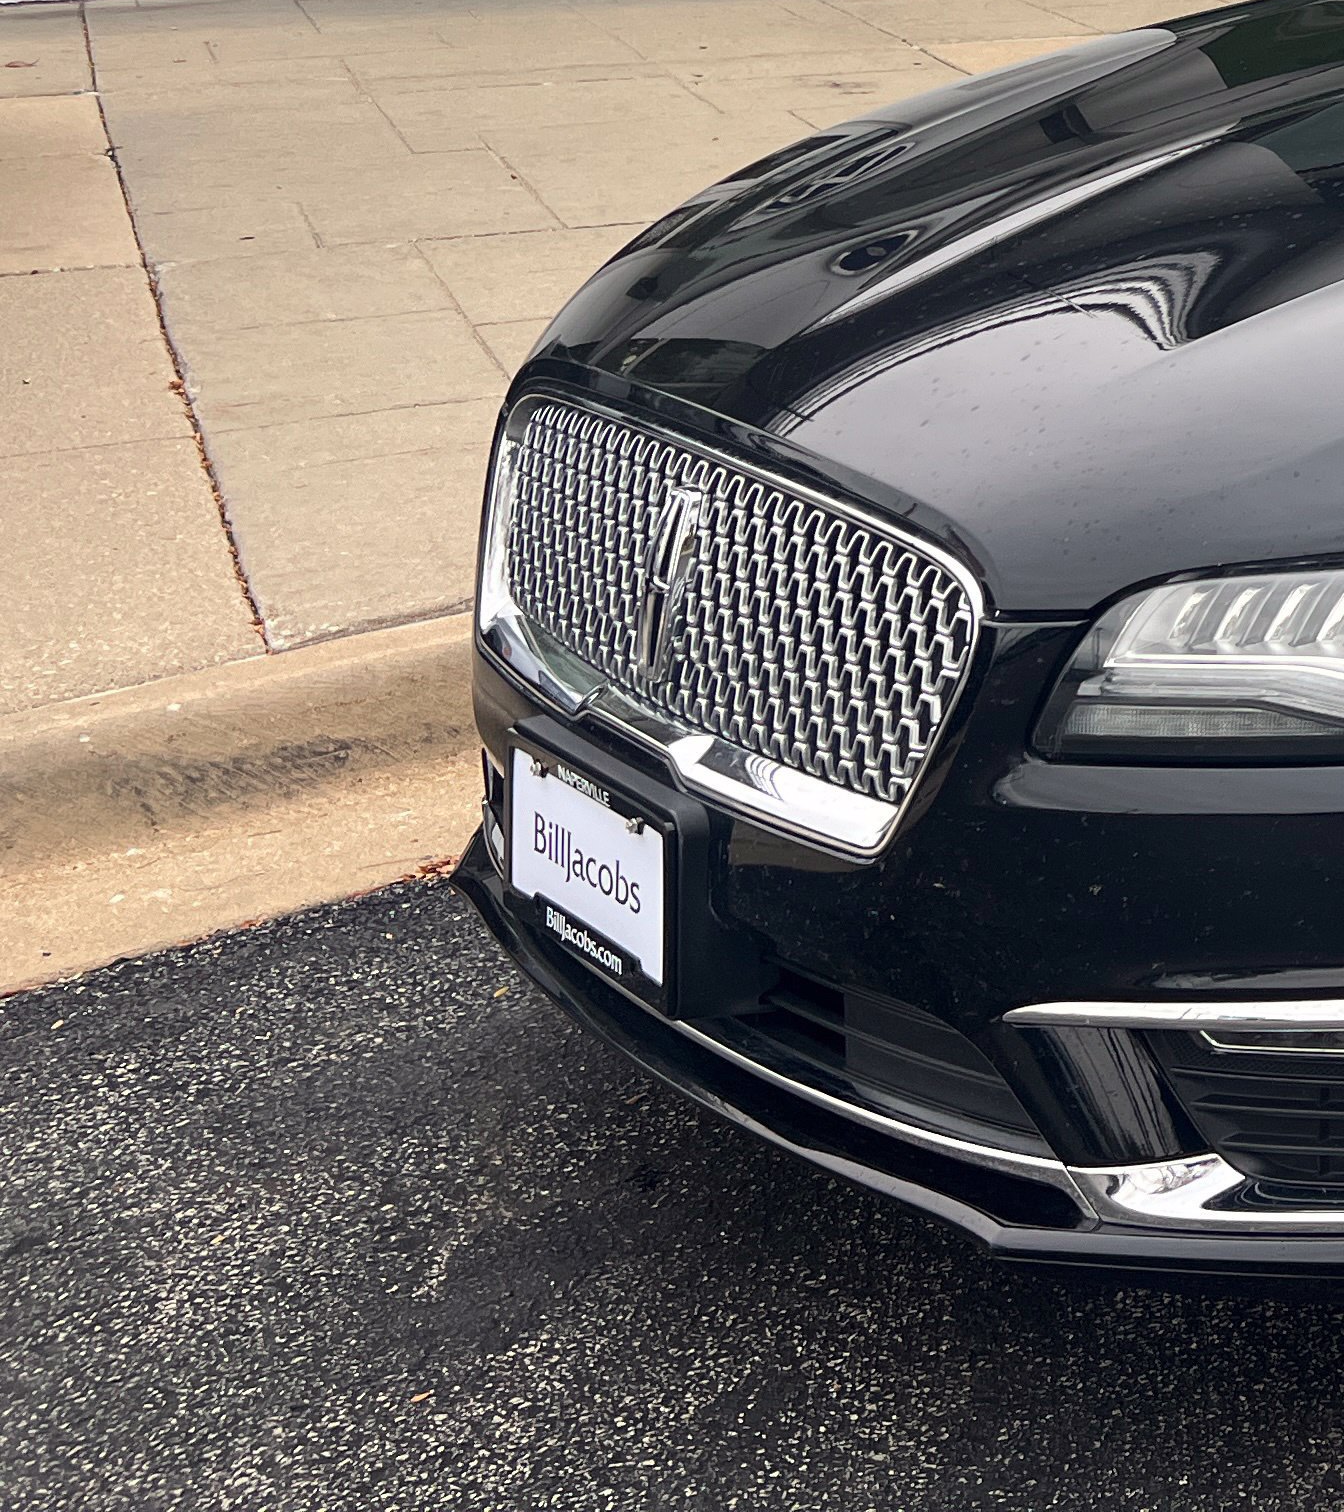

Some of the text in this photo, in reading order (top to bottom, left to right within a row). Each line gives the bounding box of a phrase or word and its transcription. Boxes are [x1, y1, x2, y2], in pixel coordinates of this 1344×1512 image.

[556, 763, 611, 808] NAPERVILLE
[533, 810, 642, 915] BillJacobs
[545, 905, 624, 976] BillJacobs.com
